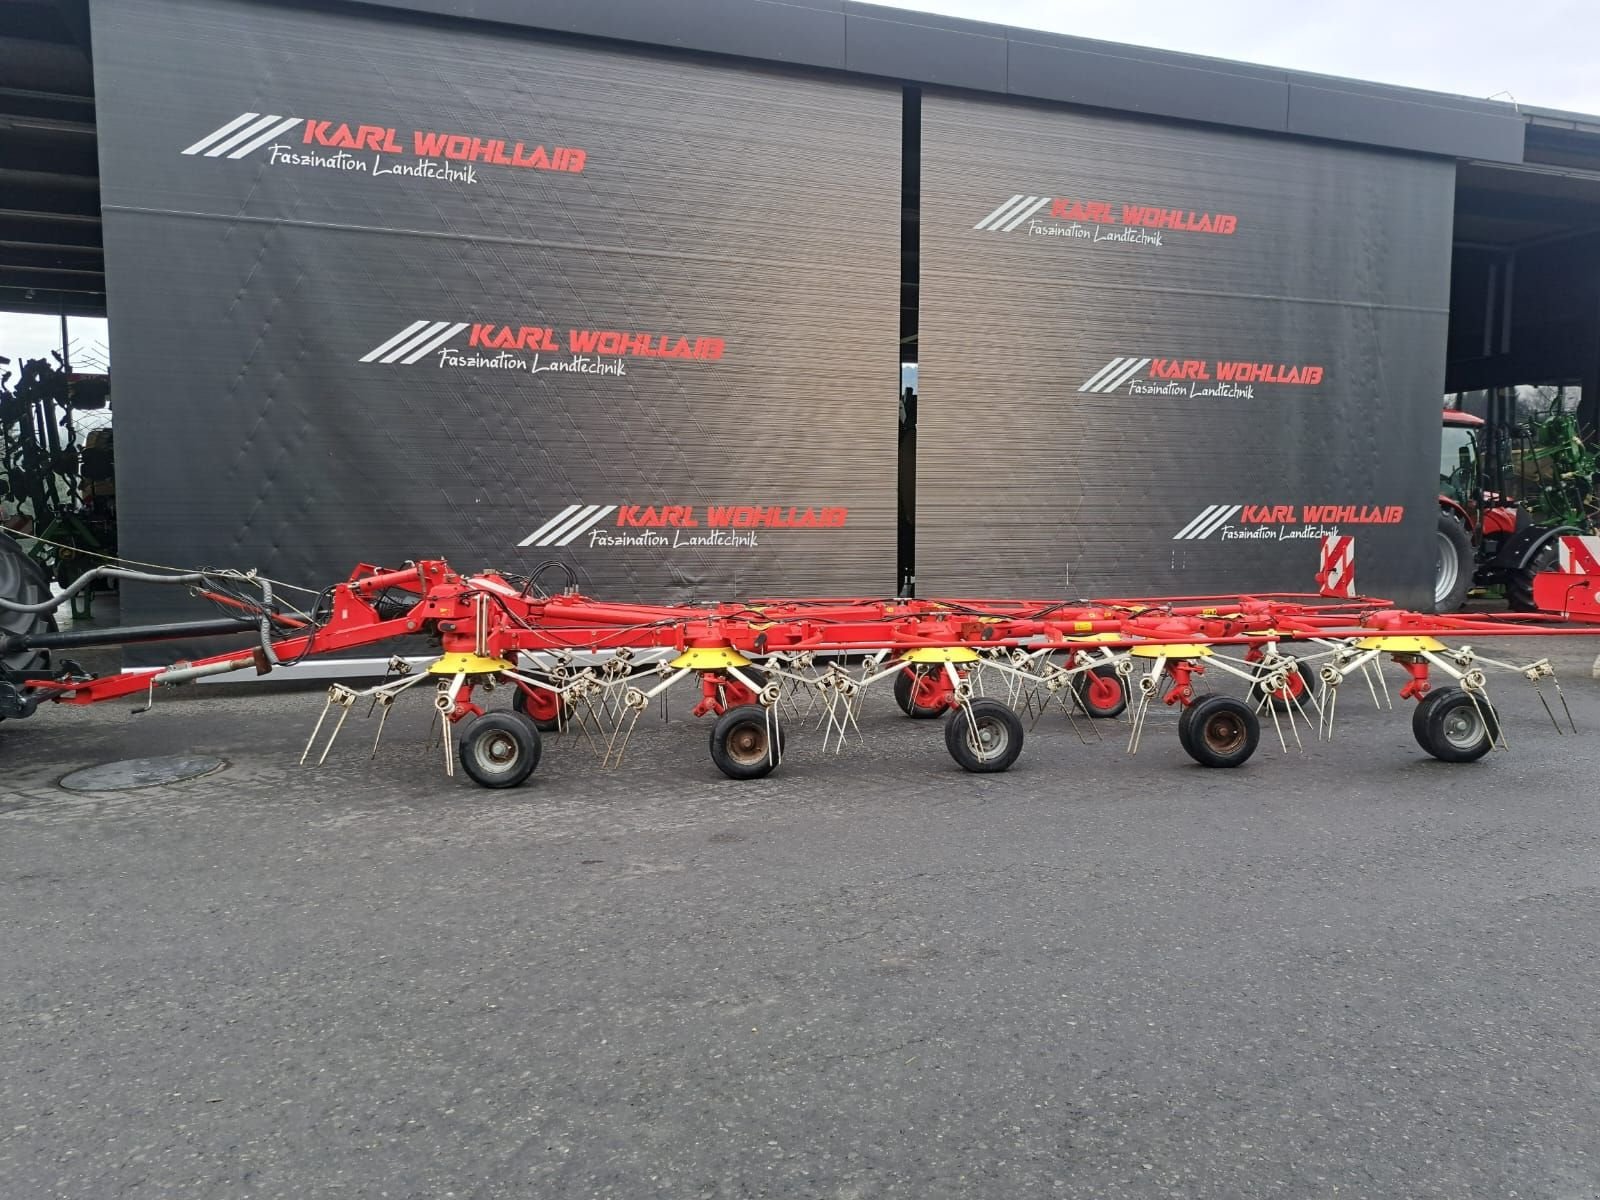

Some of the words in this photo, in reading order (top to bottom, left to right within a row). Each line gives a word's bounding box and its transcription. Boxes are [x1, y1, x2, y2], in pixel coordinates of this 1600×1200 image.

[303, 119, 402, 153] KARL
[412, 130, 588, 174] WOHLLAIB
[268, 143, 367, 172] Faszination
[372, 154, 478, 186] Landtechnik
[1050, 198, 1115, 224] KARL
[1121, 204, 1238, 235] WOHLLAIB
[1027, 218, 1091, 240] Faszination
[1093, 224, 1163, 247] Landtechnik
[468, 323, 559, 352] KARL
[569, 328, 726, 361] WOHLLAIB
[437, 346, 527, 369] Faszination
[531, 350, 627, 378] Landtechnik
[1149, 358, 1210, 381] KARL
[1215, 361, 1324, 385] WOHLLAIB
[1128, 378, 1187, 396] Faszination
[1189, 381, 1255, 400] Landtechnik
[616, 505, 699, 528] KARL
[707, 506, 849, 528] WOHLLAIB
[1240, 505, 1297, 523] KARL
[1302, 505, 1404, 523] WOHLLAIB
[588, 528, 669, 549] Faszination
[672, 528, 759, 549] Landtechnik
[1221, 524, 1277, 541] Faszination
